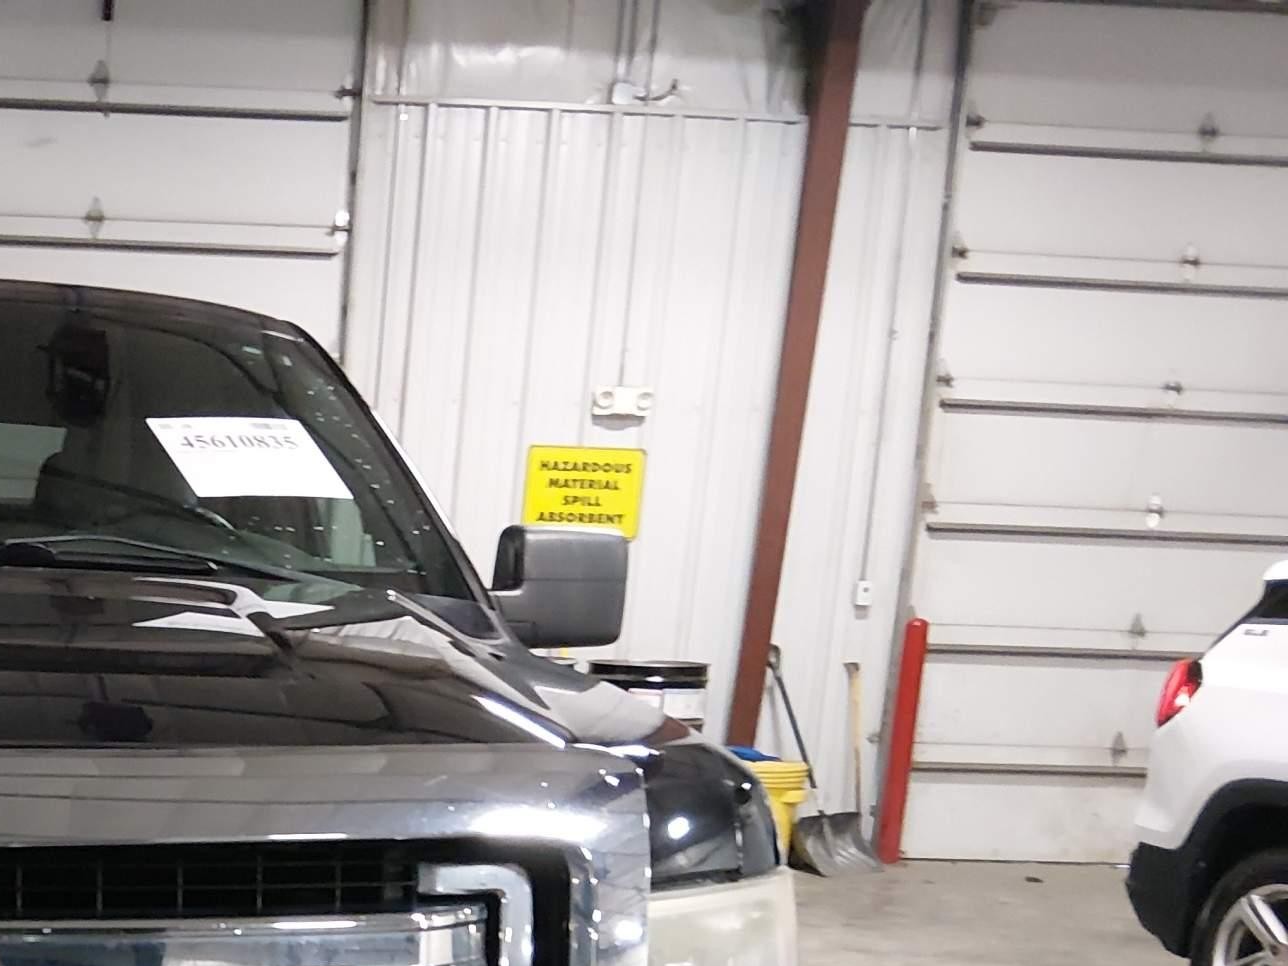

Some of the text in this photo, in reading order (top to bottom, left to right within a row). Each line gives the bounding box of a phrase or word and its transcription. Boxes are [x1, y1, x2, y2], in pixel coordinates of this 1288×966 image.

[180, 434, 299, 449] 45610835
[539, 460, 632, 474] HAZARDOUS
[548, 478, 620, 491] MATERIAL
[562, 495, 602, 507] SPILL
[535, 511, 625, 525] ABSORBENT
